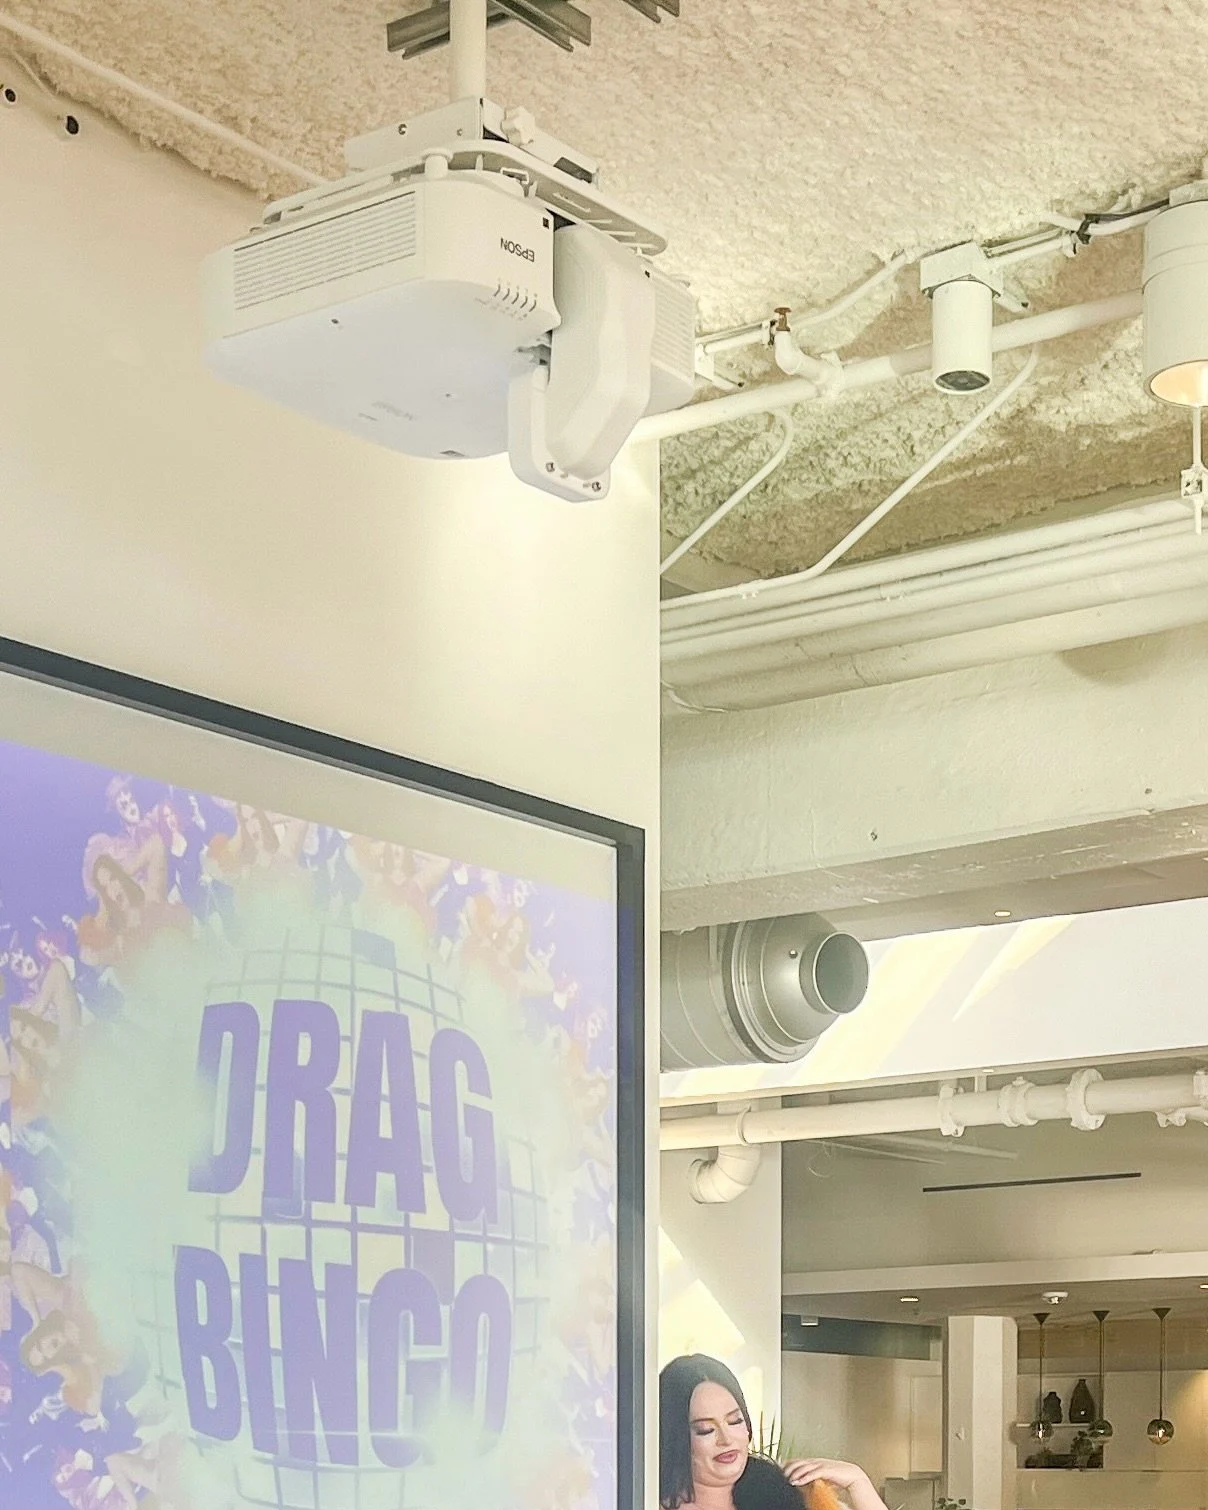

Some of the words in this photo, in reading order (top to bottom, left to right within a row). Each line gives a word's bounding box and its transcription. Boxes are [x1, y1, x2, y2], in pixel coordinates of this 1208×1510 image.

[500, 237, 535, 262] EPSON
[188, 1000, 500, 1225] DRAG
[174, 1245, 513, 1468] BINGO
